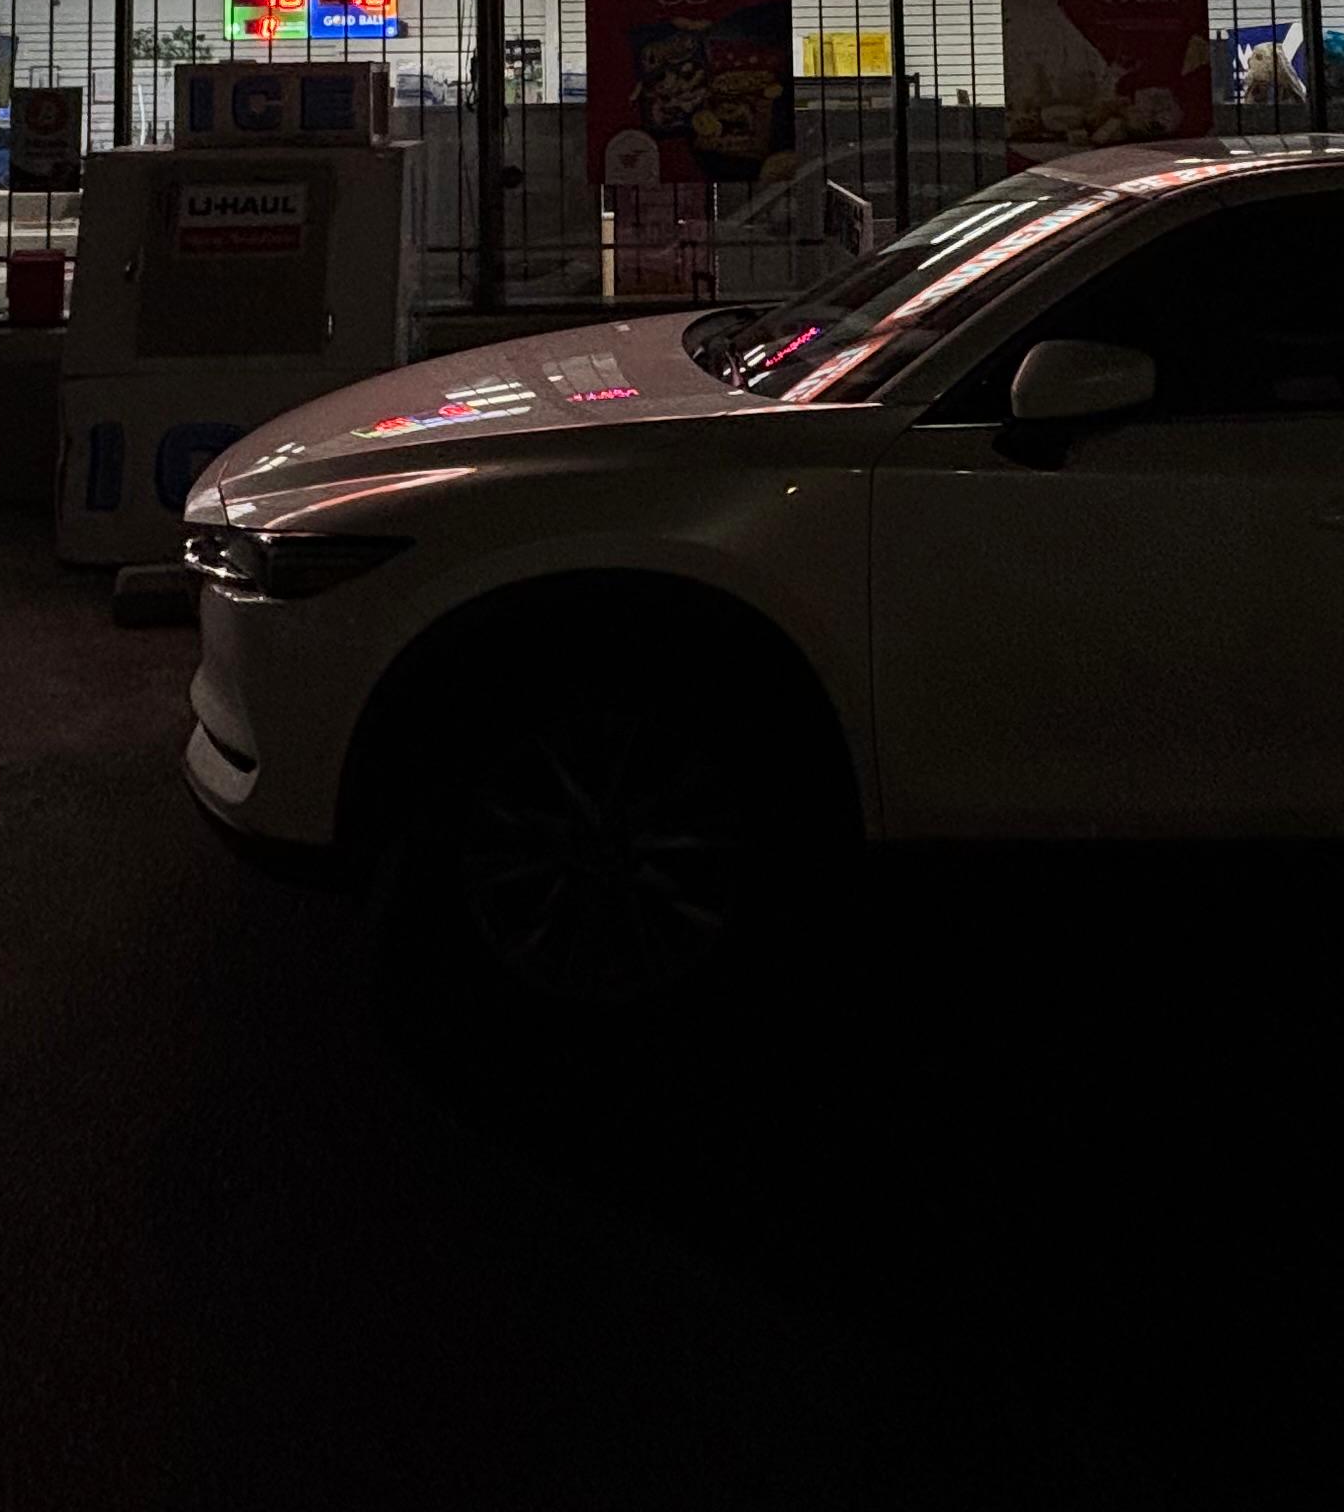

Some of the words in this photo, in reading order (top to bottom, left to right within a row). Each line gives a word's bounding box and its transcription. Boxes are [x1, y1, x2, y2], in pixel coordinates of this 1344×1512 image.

[189, 74, 354, 133] ICE
[188, 195, 297, 216] U-HAUL
[86, 421, 248, 513] IC
